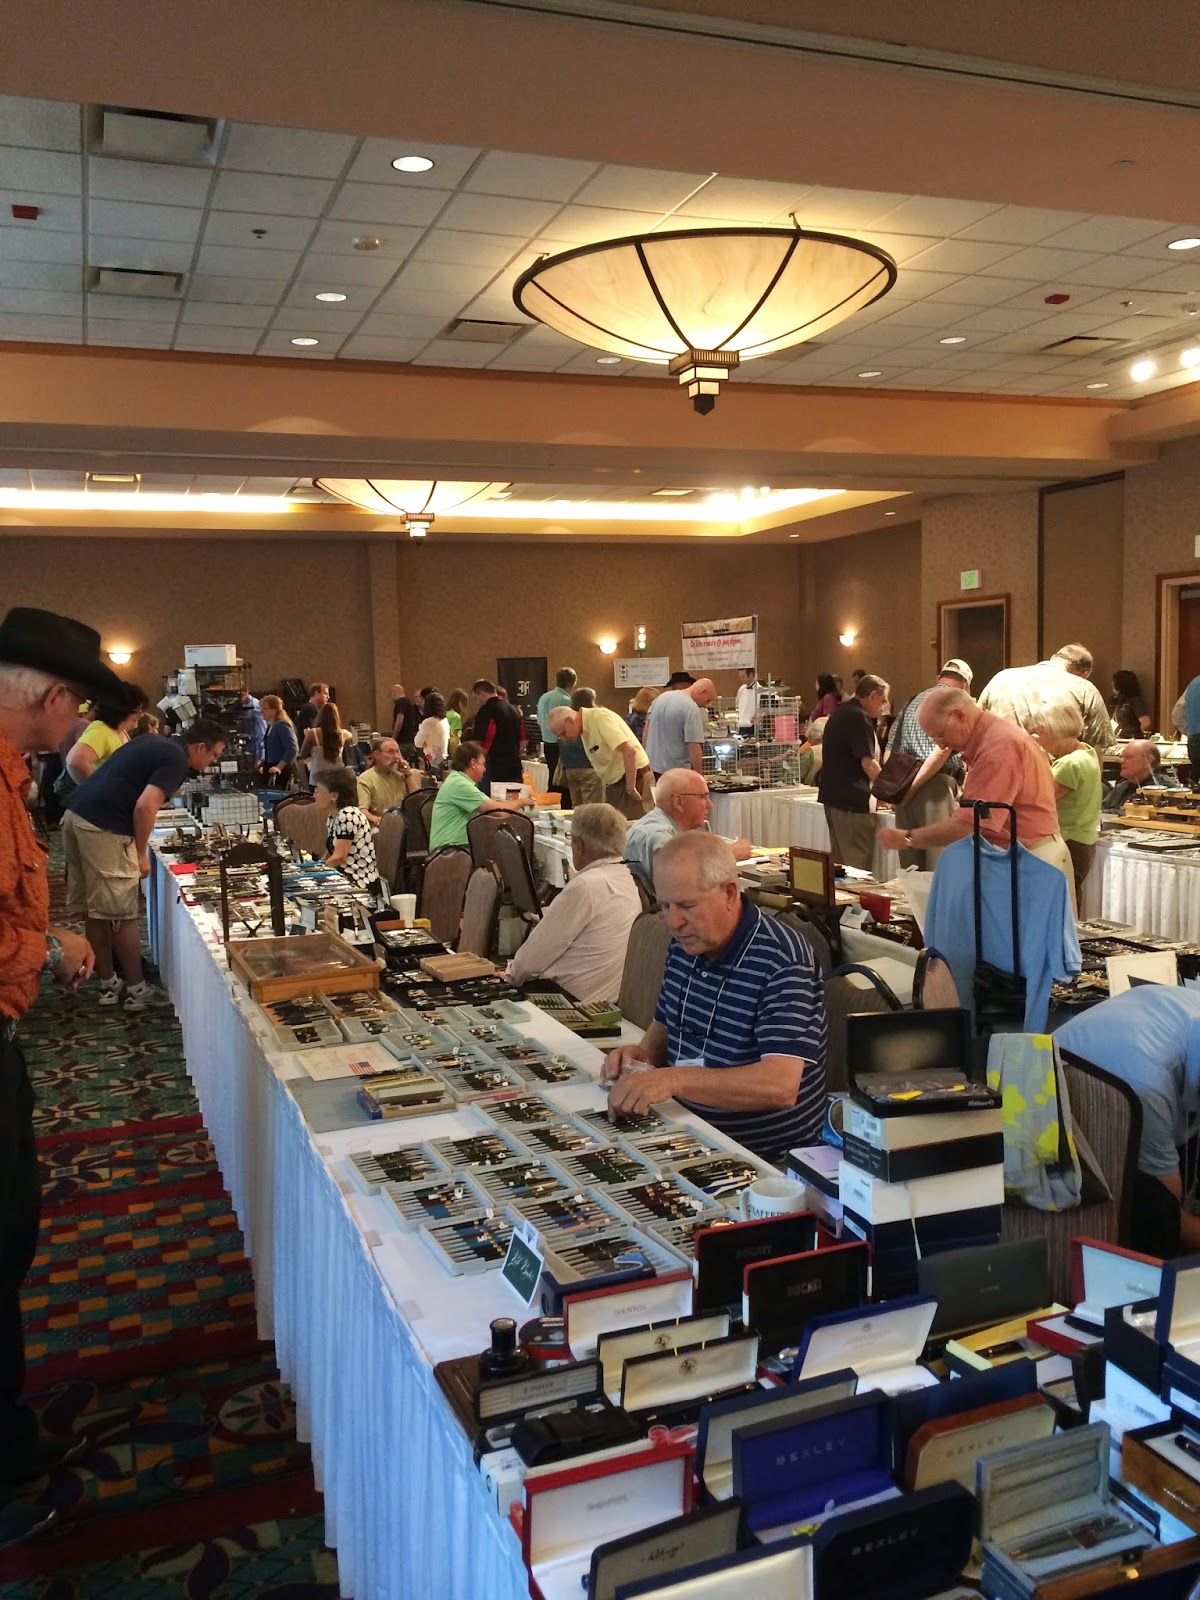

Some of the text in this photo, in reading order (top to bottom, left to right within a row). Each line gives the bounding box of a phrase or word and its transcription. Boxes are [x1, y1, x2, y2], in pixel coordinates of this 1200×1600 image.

[786, 1279, 823, 1297] DUCATI
[775, 1435, 847, 1466] BEXLEY
[945, 1434, 1005, 1458] BEXLEY
[851, 1527, 920, 1556] BEXLEY
